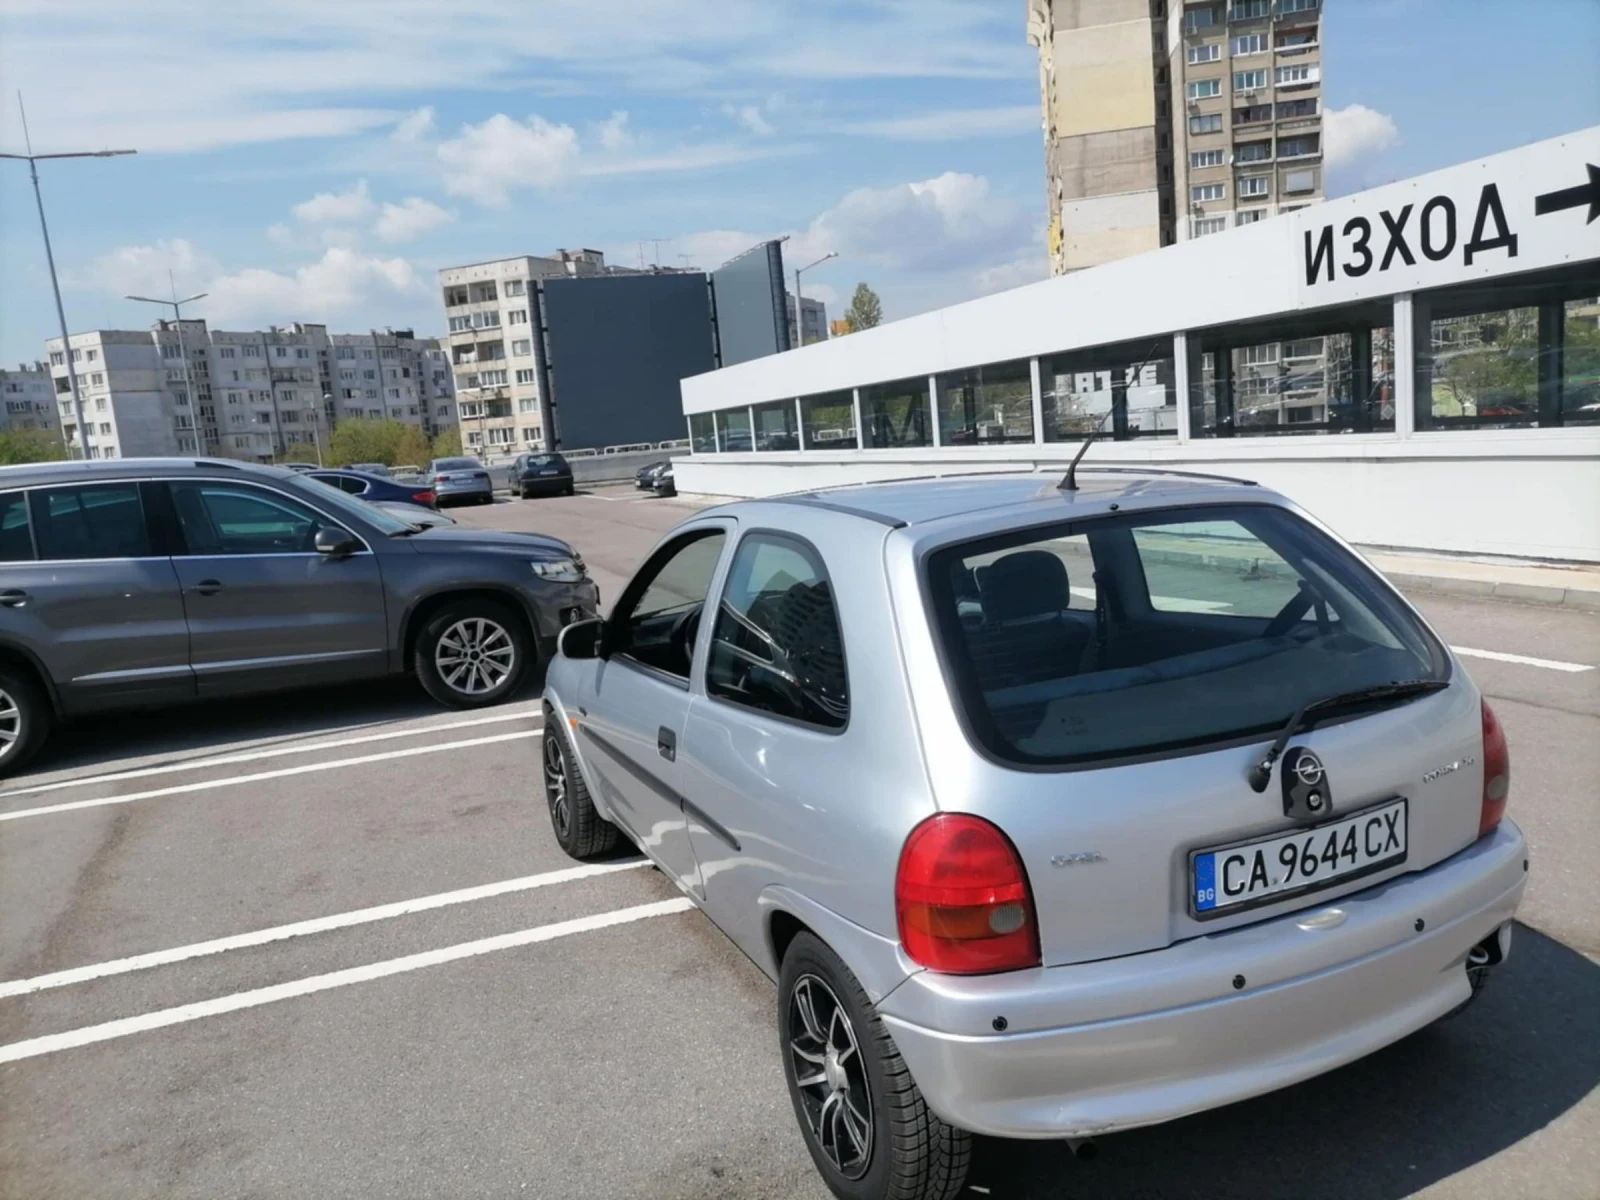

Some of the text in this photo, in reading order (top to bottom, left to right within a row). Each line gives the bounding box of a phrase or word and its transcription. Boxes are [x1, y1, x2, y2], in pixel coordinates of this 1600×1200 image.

[1304, 182, 1518, 286] ИЗХОД
[1197, 888, 1214, 903] BG
[1223, 809, 1400, 896] CA 9644 CX
